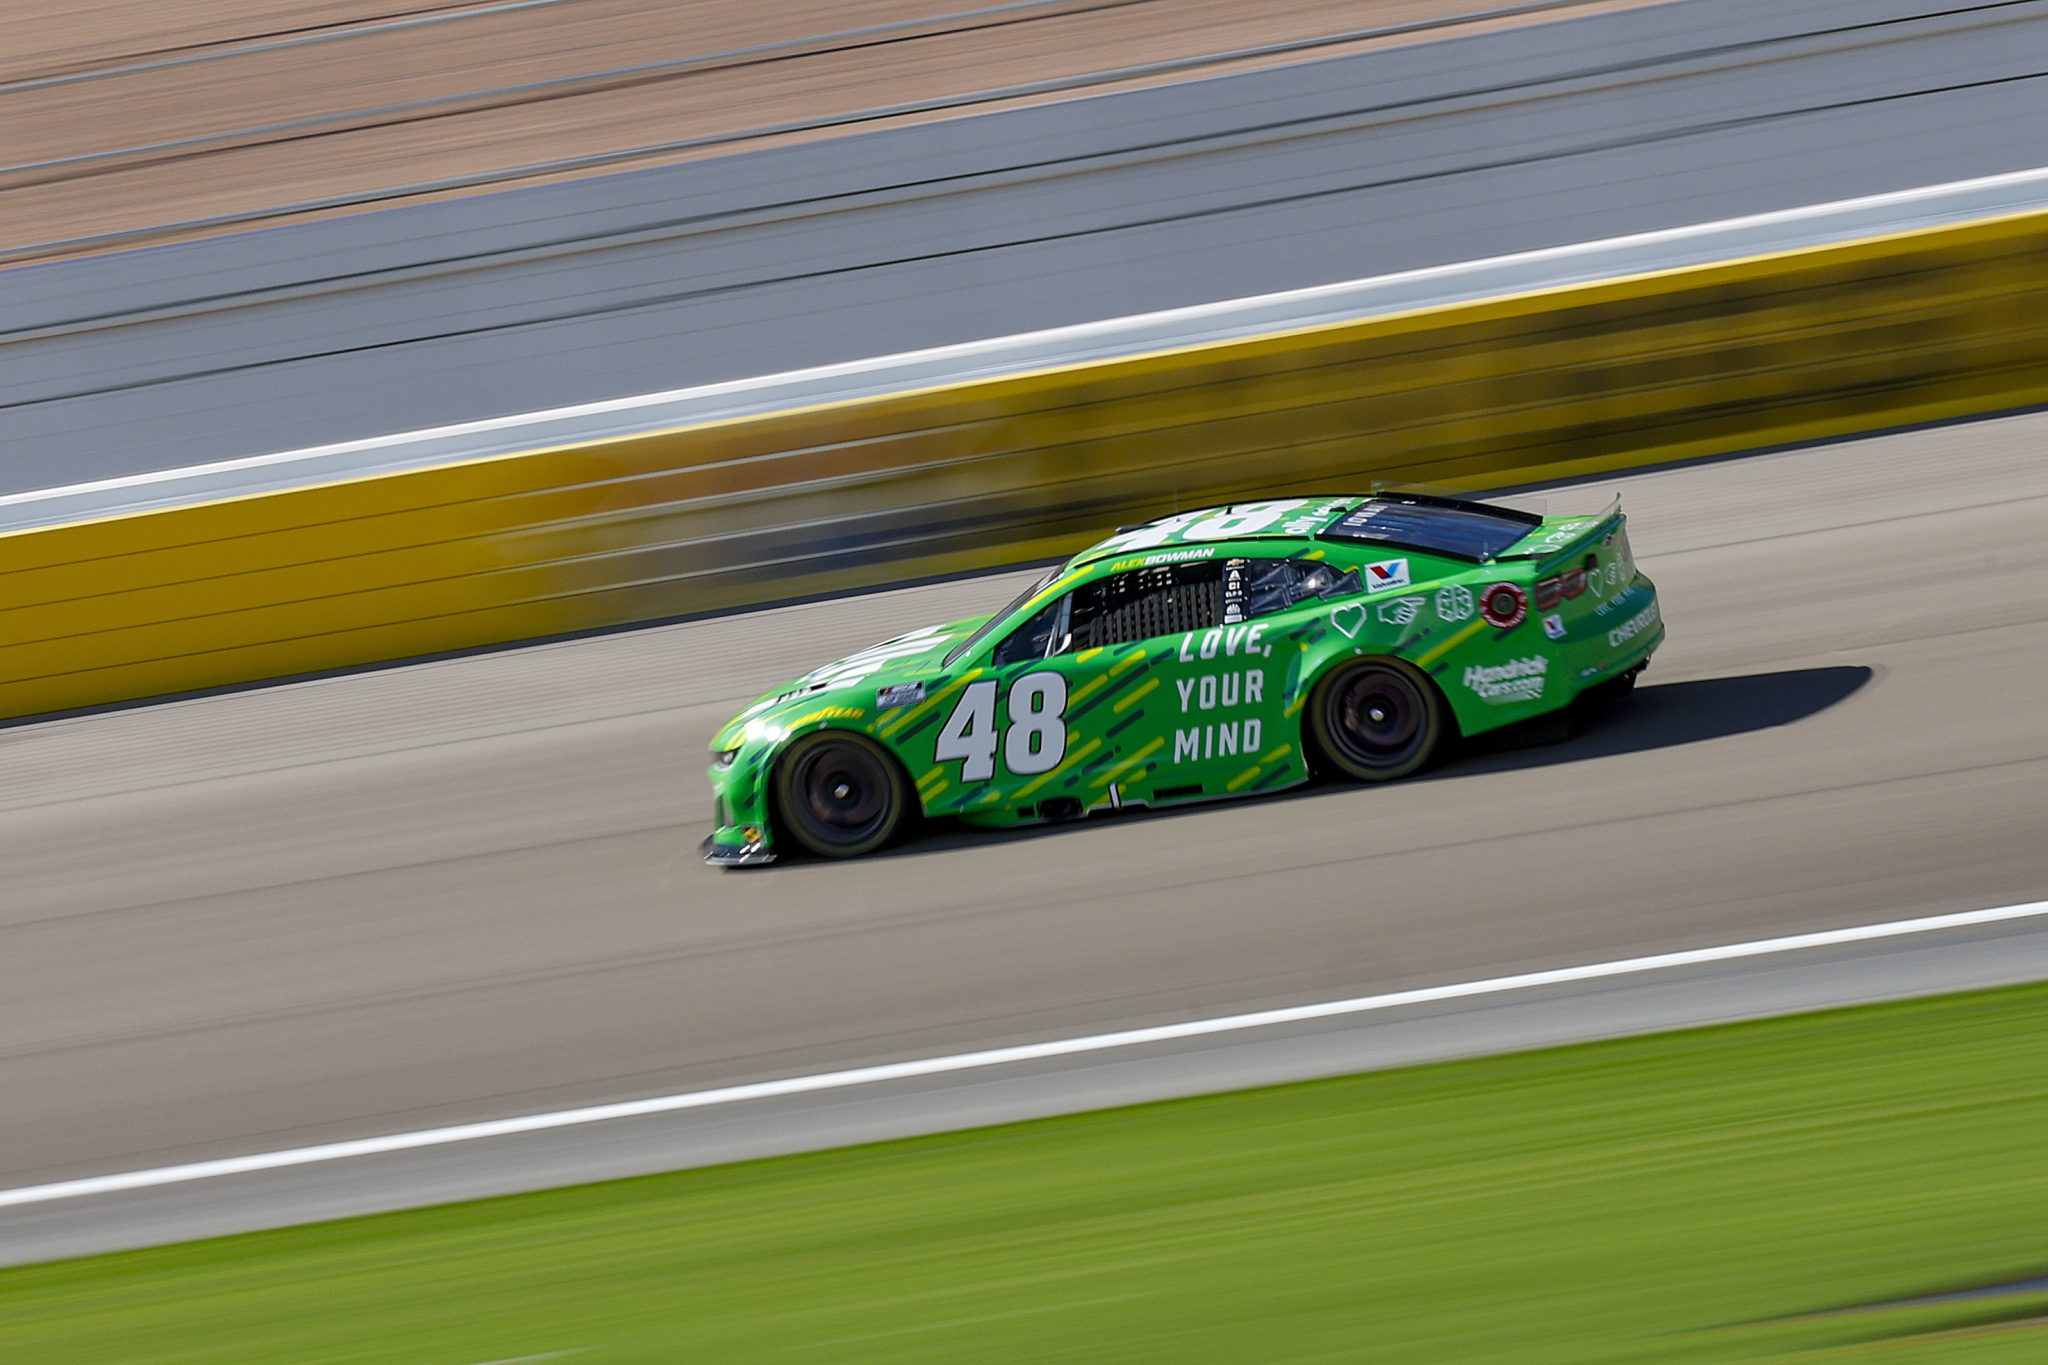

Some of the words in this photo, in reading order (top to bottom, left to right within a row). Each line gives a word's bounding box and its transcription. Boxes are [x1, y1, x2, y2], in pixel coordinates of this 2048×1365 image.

[1179, 623, 1273, 663] LOVE,
[1176, 669, 1265, 713] YOUR
[934, 670, 1069, 784] 48
[1174, 719, 1262, 765] MIND
